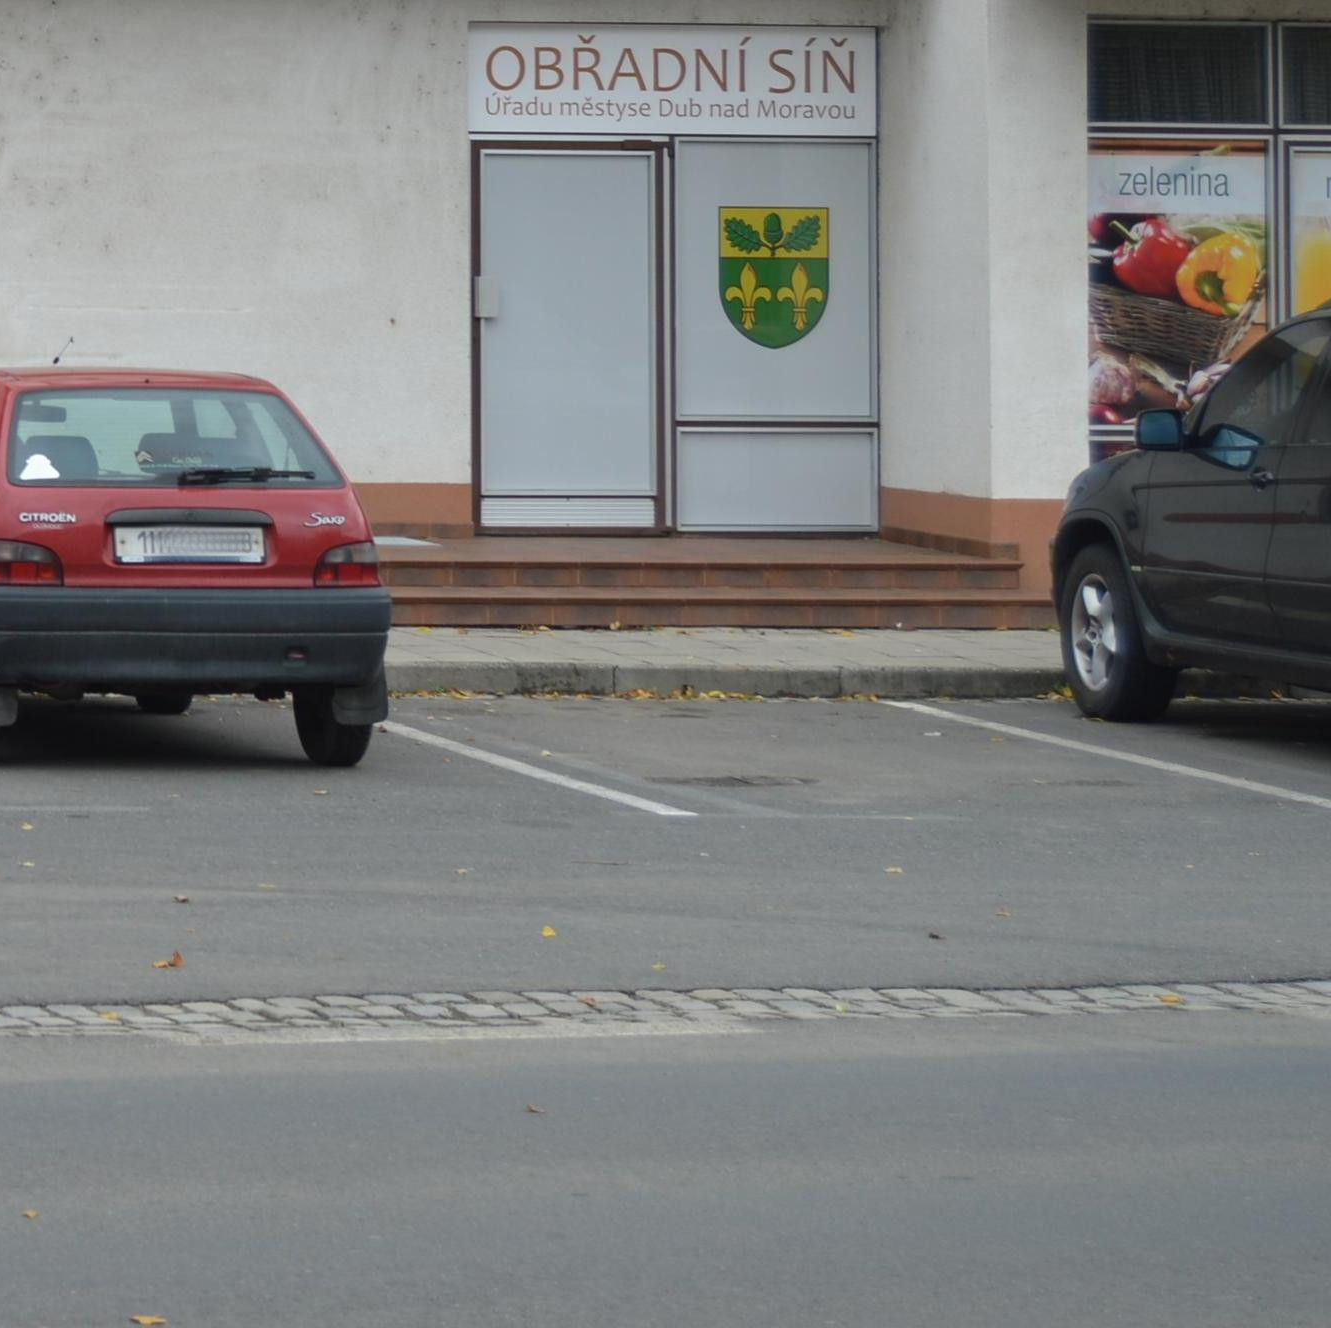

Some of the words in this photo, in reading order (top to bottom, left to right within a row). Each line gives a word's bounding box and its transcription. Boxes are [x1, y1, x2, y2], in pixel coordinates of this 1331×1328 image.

[484, 34, 751, 92] OBŘADNÍ
[768, 36, 856, 94] SÍŇ
[485, 92, 553, 117] Úřadu
[559, 96, 651, 122] městyse
[658, 99, 702, 118] Dub
[709, 100, 749, 119] nad
[757, 99, 856, 120] Moravou
[1118, 166, 1230, 197] zelenina
[19, 510, 76, 523] CITROËN
[304, 511, 345, 527] Saxo
